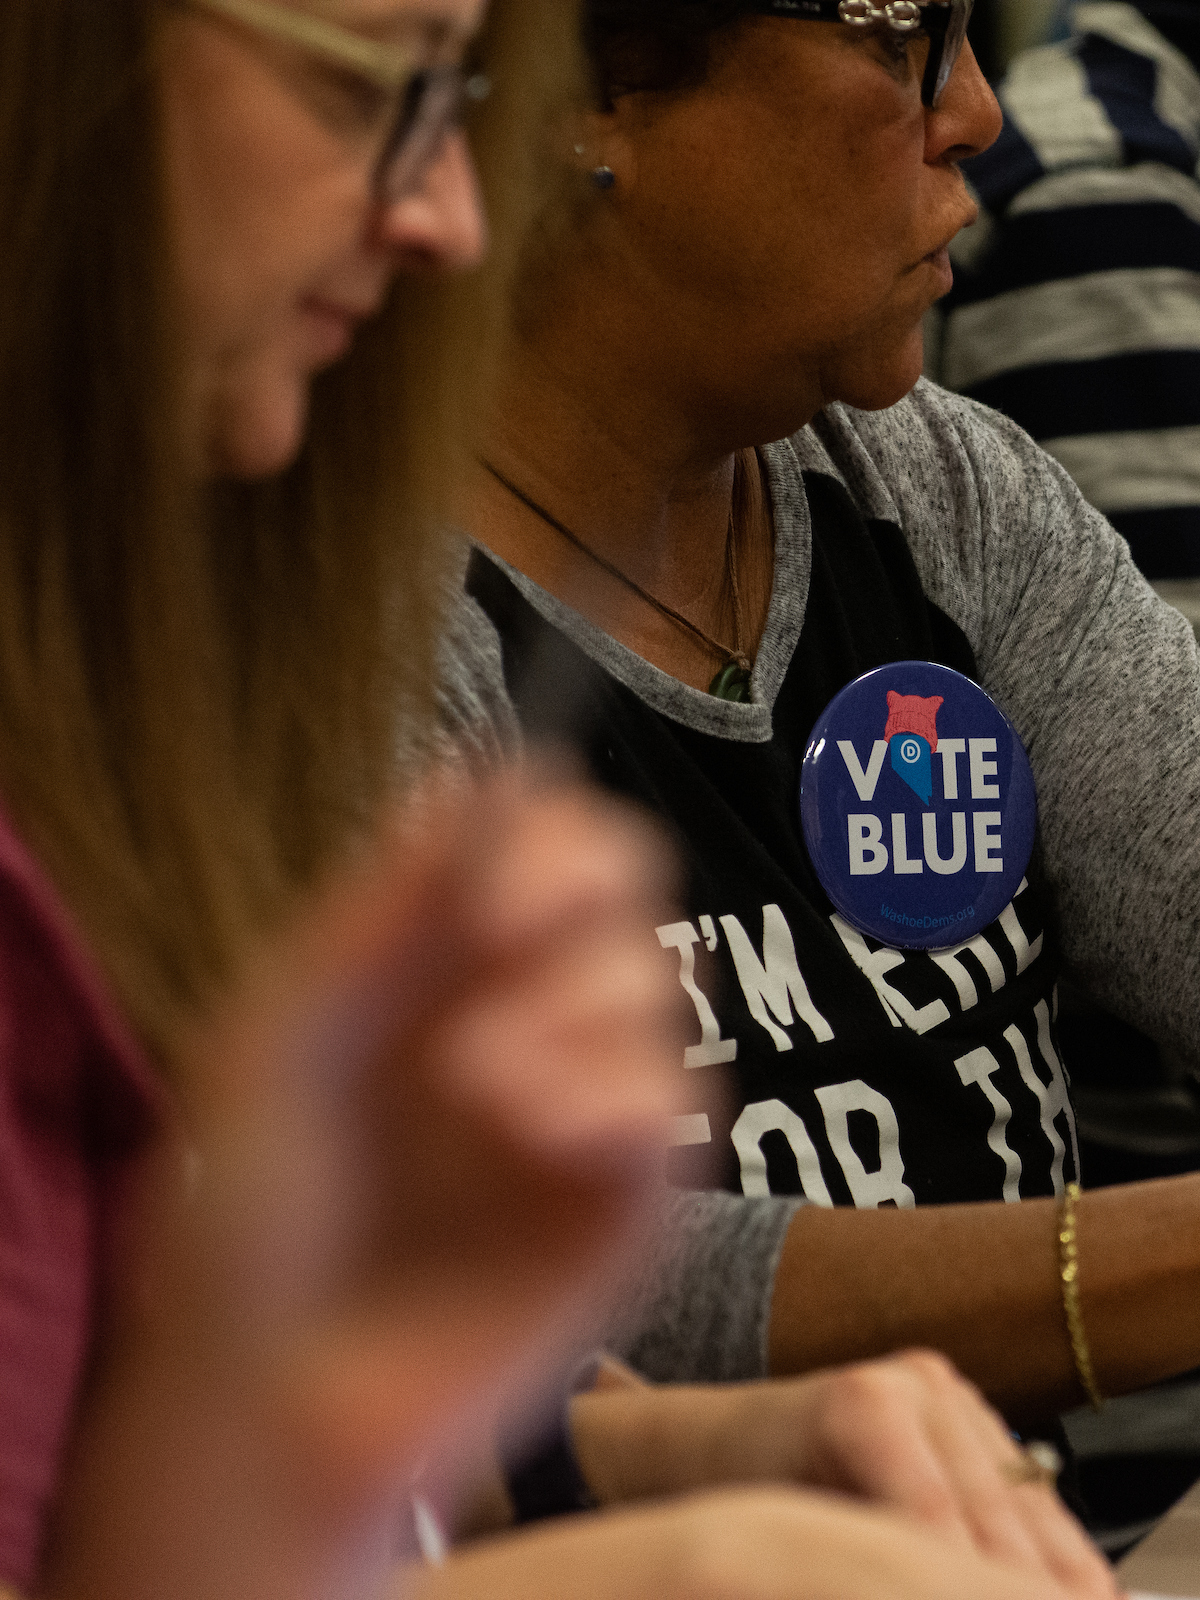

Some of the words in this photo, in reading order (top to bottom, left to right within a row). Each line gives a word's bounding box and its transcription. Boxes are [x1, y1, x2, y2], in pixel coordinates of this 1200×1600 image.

[836, 737, 1000, 801] VTE
[906, 745, 916, 757] D
[846, 811, 1004, 876] BLUE
[880, 903, 975, 930] WashoeDems.org
[654, 903, 835, 1069] I'M
[829, 876, 1045, 1036] ERE
[668, 1079, 916, 1209] OR
[953, 995, 1081, 1204] TH
